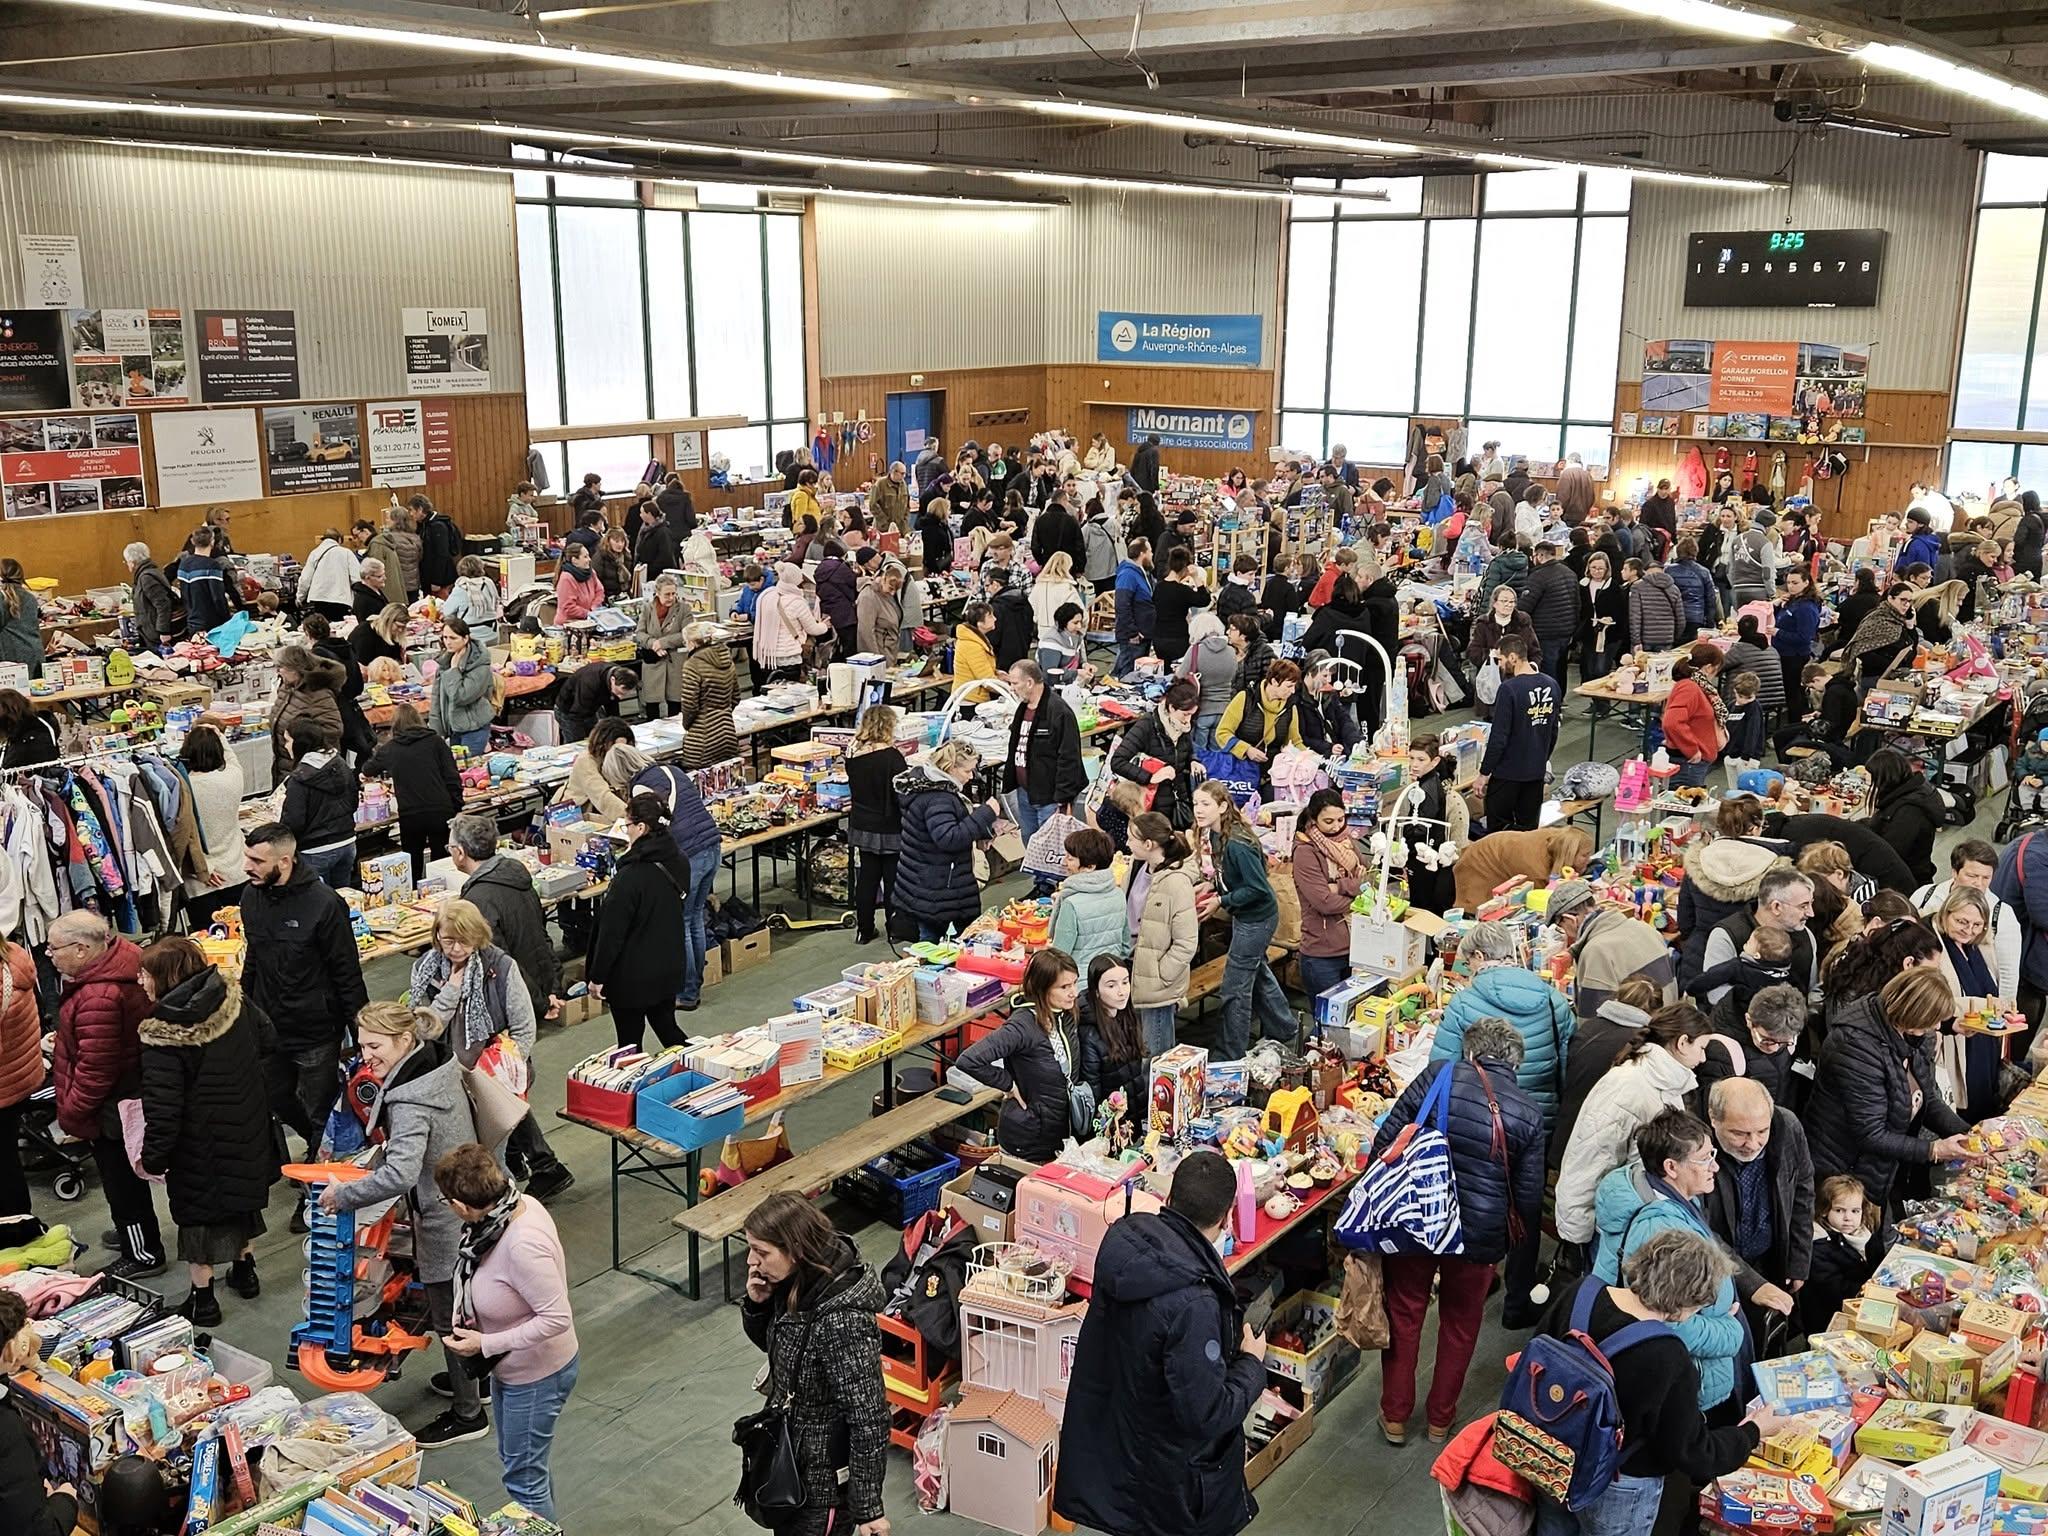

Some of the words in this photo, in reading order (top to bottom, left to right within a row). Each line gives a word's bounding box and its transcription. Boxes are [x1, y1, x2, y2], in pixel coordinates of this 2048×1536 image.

[1769, 232, 1805, 249] 9:25
[1696, 263, 1701, 274] 1
[1718, 263, 1726, 273] 2
[1741, 263, 1750, 273] 3
[1764, 262, 1772, 273] 4
[1788, 262, 1797, 273] 5
[1813, 261, 1821, 272] 6
[1837, 261, 1846, 272] 7
[1861, 261, 1870, 272] 8
[431, 316, 464, 327] KOMEIX
[1142, 323, 1159, 337] La
[1161, 323, 1211, 340] Région
[1142, 341, 1247, 355] Auvergne-Rhône-Alpes
[1721, 367, 1749, 375] GARAGE
[1750, 368, 1788, 376] MORELLON
[312, 406, 354, 420] RENAULT
[1137, 408, 1225, 433] Mornant
[1132, 433, 1175, 446] Partaire
[1176, 437, 1192, 446] des
[1193, 438, 1248, 450] associations
[67, 451, 90, 459] GARAGE
[1528, 686, 1553, 706] BTZ
[1209, 778, 1256, 791] EXEL
[201, 1442, 216, 1477] SCRABBLE
